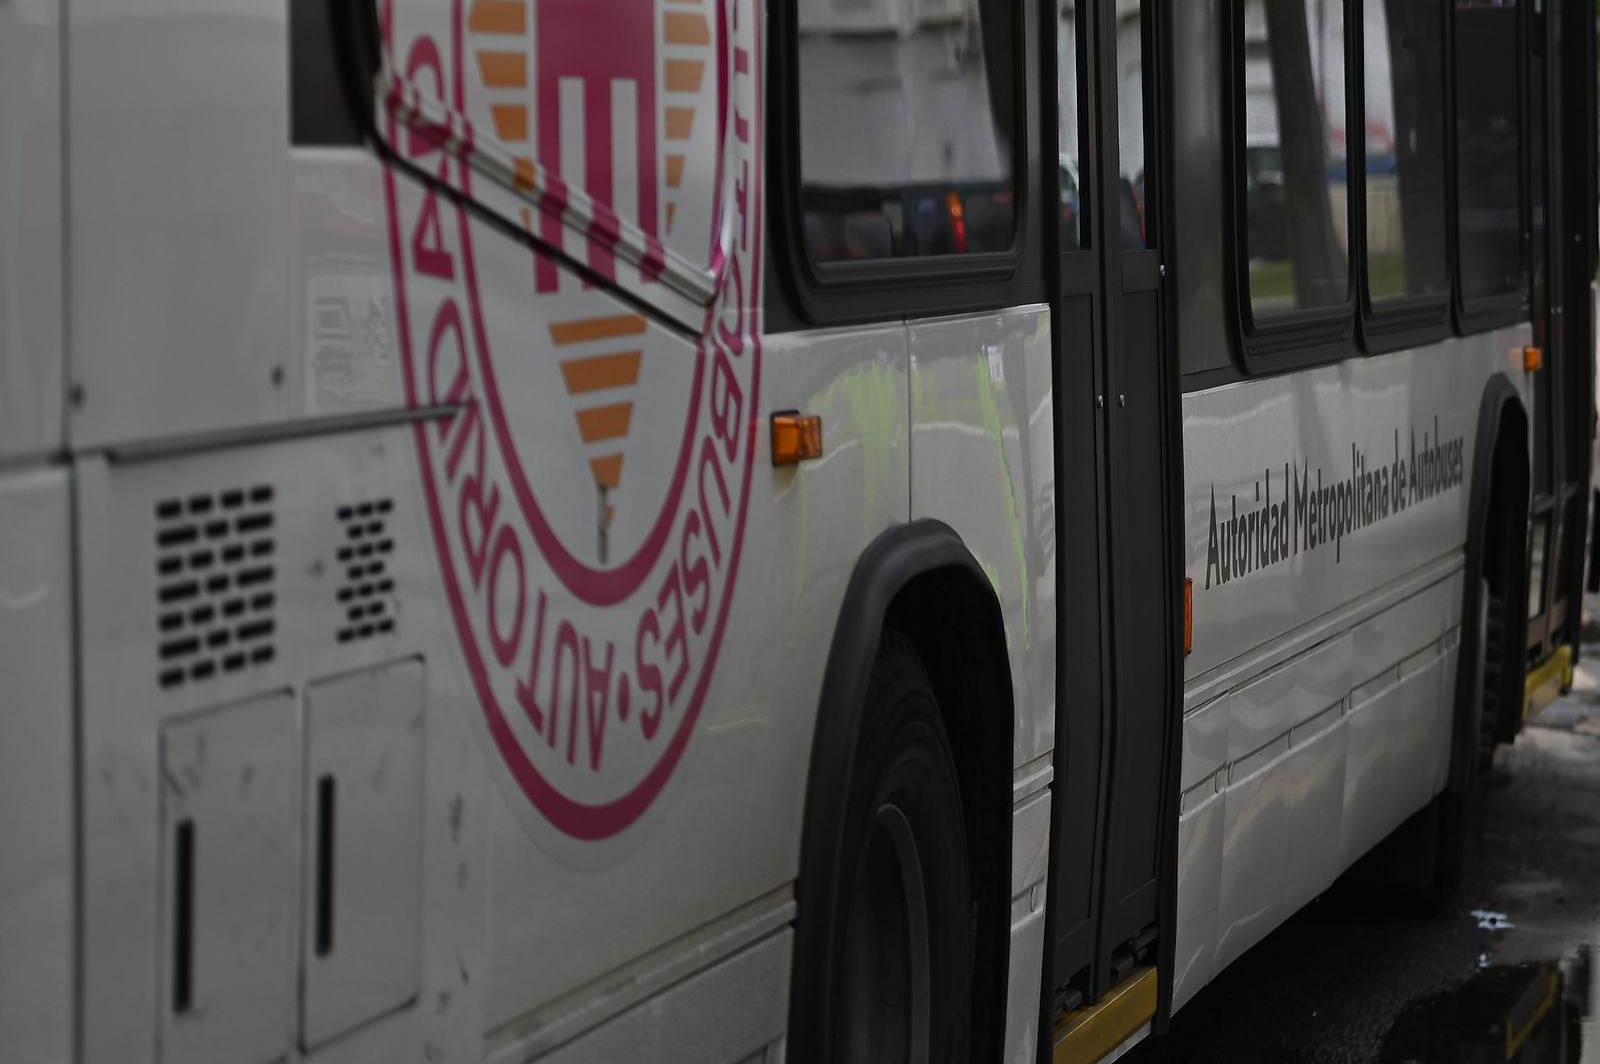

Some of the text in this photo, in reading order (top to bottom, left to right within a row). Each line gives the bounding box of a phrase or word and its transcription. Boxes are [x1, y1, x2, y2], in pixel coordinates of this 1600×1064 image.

[1205, 414, 1464, 590] Autoridad Metropolitana de Autobuses
